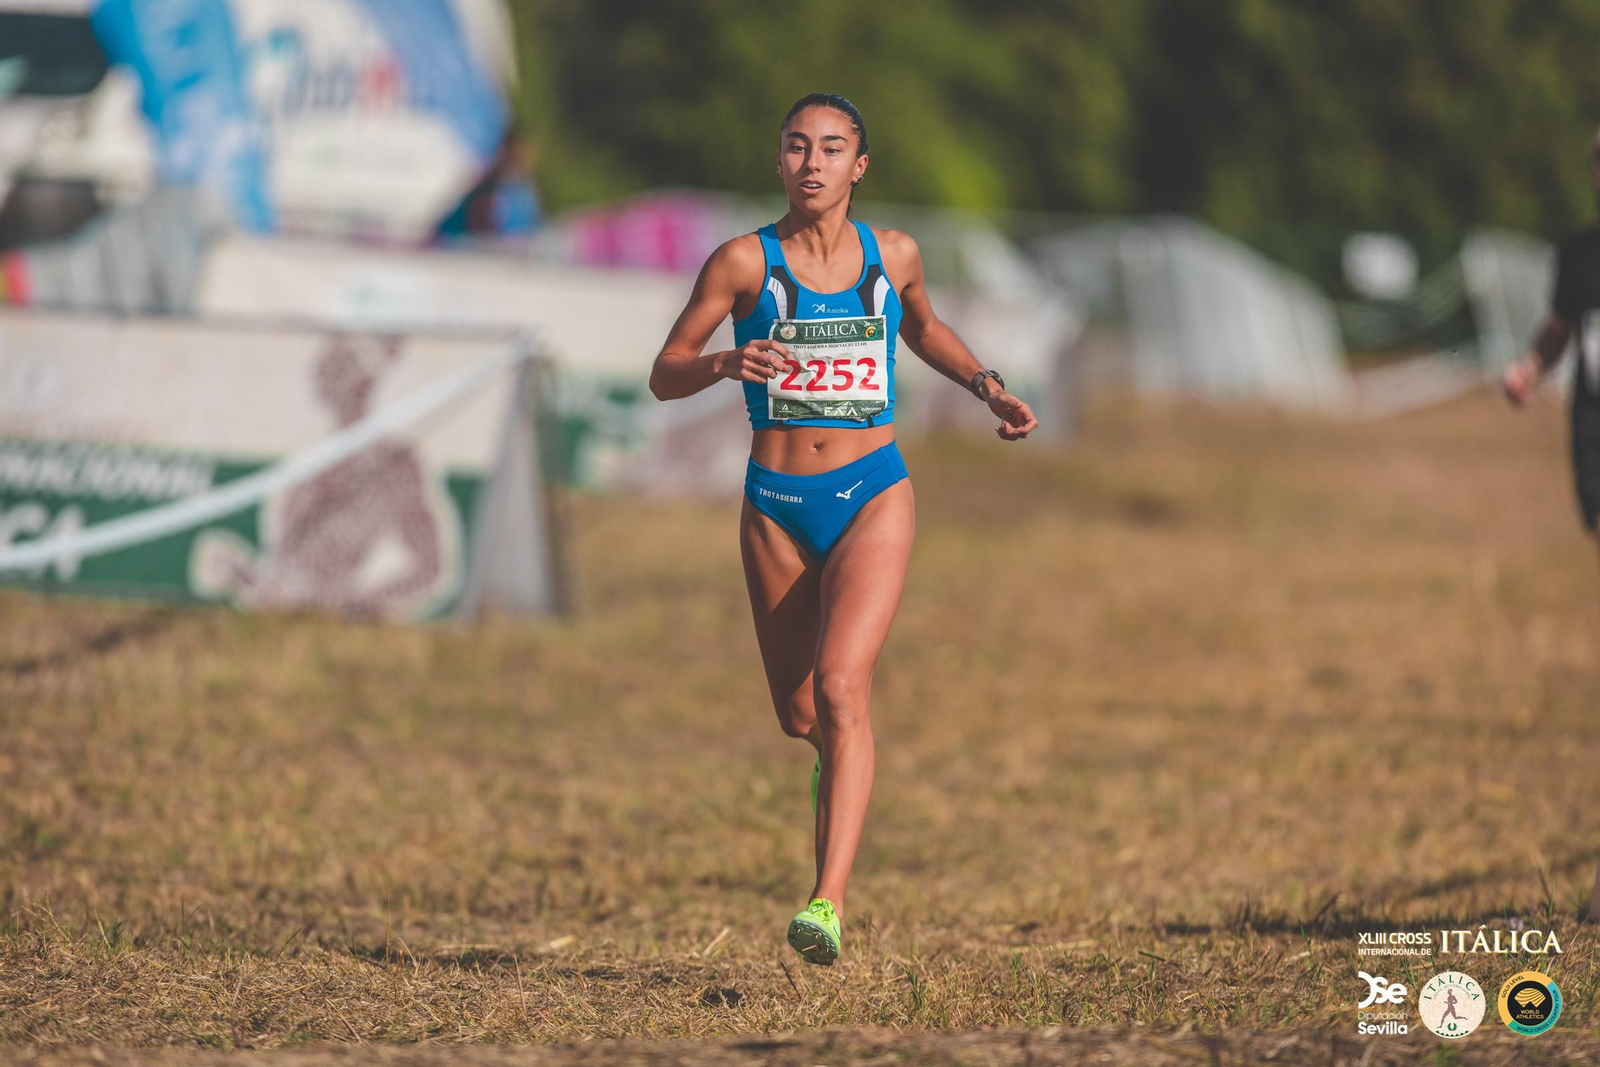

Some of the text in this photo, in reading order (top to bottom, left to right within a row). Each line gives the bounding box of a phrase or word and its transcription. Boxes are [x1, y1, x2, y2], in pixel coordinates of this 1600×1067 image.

[804, 323, 858, 337] ITÁLICA
[780, 357, 880, 392] 2252
[759, 487, 803, 504] TROTASIERRA
